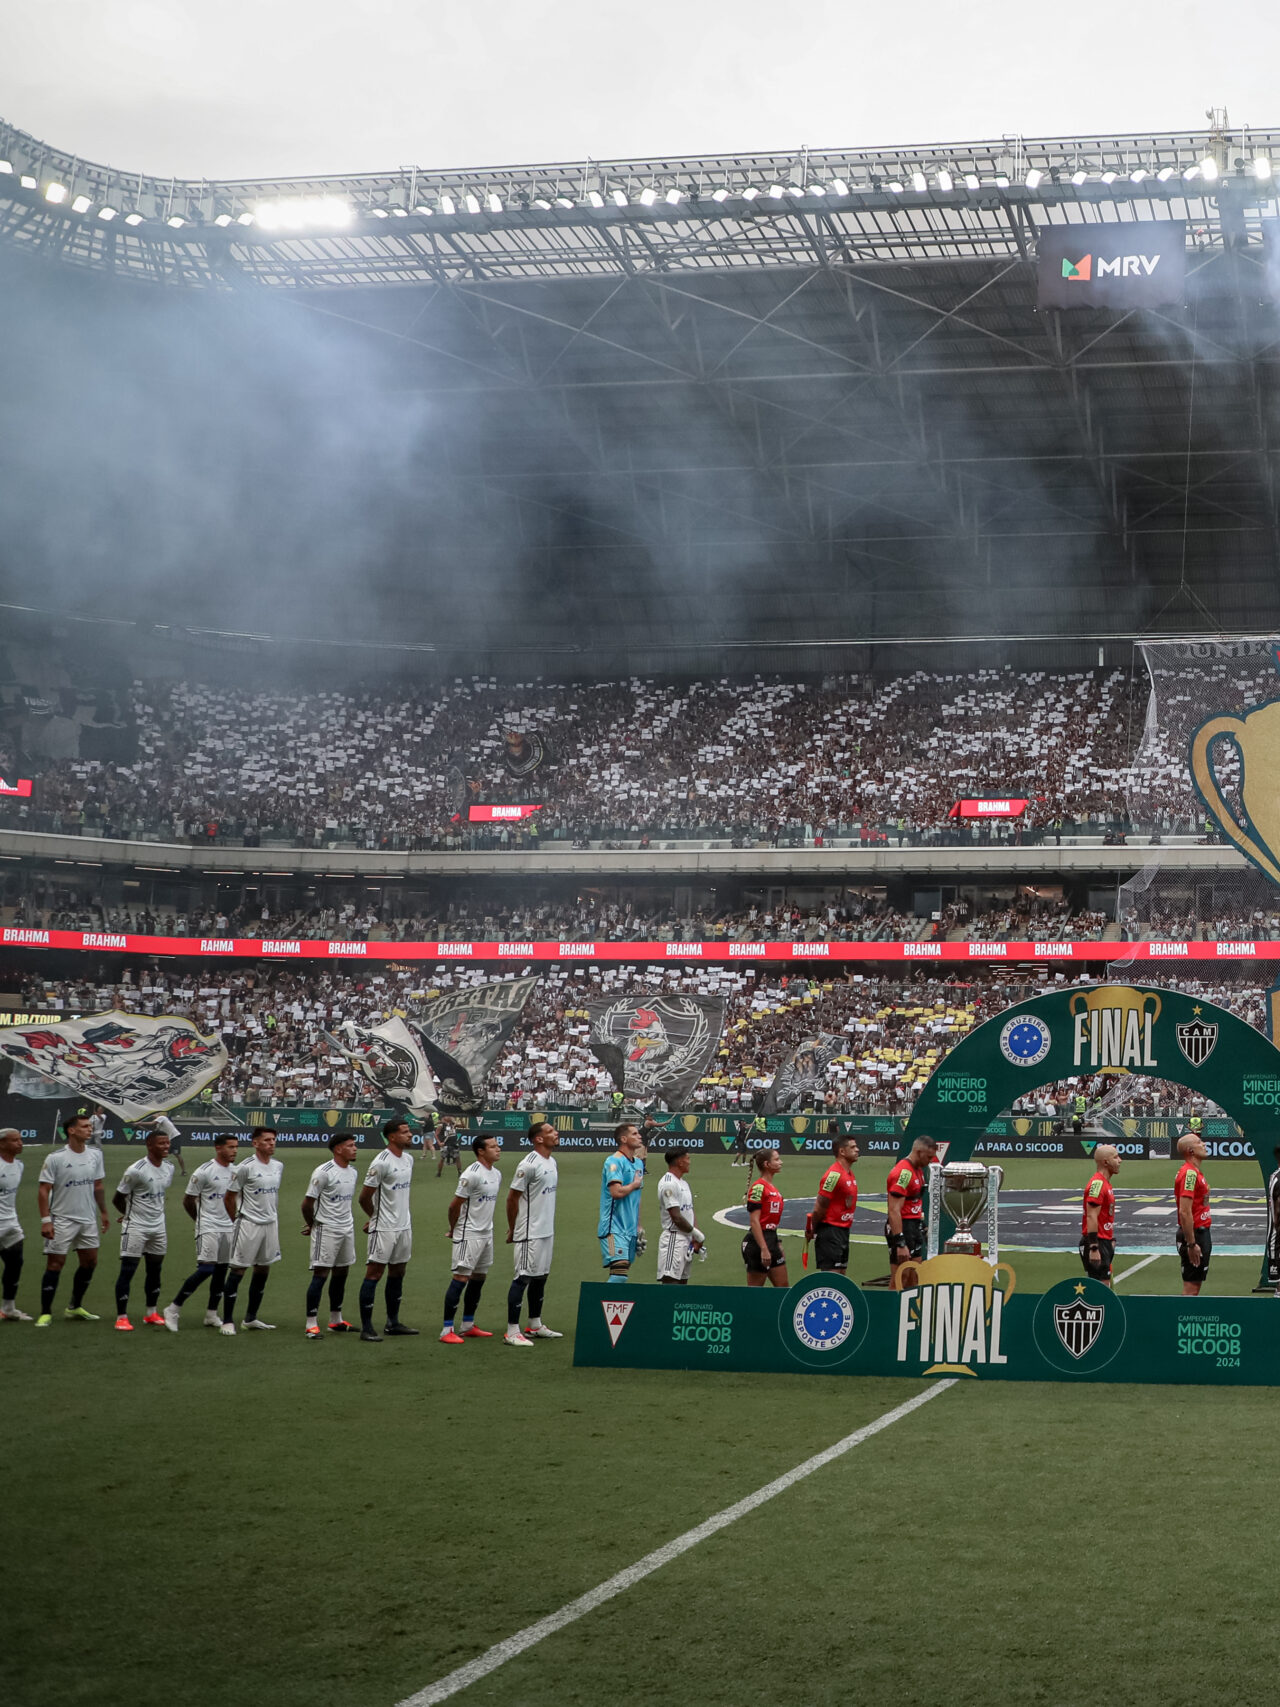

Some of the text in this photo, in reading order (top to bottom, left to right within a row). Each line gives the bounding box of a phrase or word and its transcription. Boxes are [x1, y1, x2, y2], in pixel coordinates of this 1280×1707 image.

[1097, 255, 1161, 277] MRV
[491, 807, 522, 817] BRAHMA
[978, 801, 1011, 812] BRAHMA
[3, 929, 49, 943] BRAHMA
[83, 934, 126, 947] BRAHMA
[262, 942, 300, 953] BRAHMA
[329, 943, 366, 954] BRAHMA
[438, 944, 472, 955] BRAHMA
[498, 944, 533, 955] BRAHMA
[560, 944, 594, 955] BRAHMA
[666, 944, 702, 955] BRAHMA
[729, 944, 765, 955] BRAHMA
[793, 944, 829, 955] BRAHMA
[904, 944, 941, 955] BRAHMA
[969, 944, 1006, 955] BRAHMA
[1035, 944, 1072, 955] BRAHMA
[1150, 943, 1188, 955] BRAHMA
[1217, 943, 1256, 955] BRAHMA
[1006, 1017, 1046, 1032] CRUZEIRO
[1182, 1028, 1212, 1036] CAM
[1074, 1008, 1157, 1068] FINAL
[1002, 1036, 1049, 1064] ESPORTE CLUBE
[937, 1078, 987, 1089] MINEIRO
[937, 1090, 987, 1103] SICOOB
[968, 1105, 988, 1113] 2024
[191, 1132, 211, 1141] SAIA
[296, 1133, 319, 1143] PARA
[320, 1133, 329, 1143] O
[744, 1138, 780, 1148] COOB
[806, 1140, 833, 1150] SICO
[868, 1141, 891, 1150] SAIA
[987, 1142, 1013, 1152] PARA
[1014, 1142, 1023, 1152] O
[1026, 1143, 1063, 1152] SICOOB
[932, 1192, 940, 1220] SICOOB
[988, 1208, 996, 1236] SICOOB
[988, 1237, 996, 1255] 2024
[801, 1290, 848, 1309] CRUZEIRO
[606, 1303, 629, 1314] FMF
[674, 1302, 713, 1310] CAMPEONATO
[672, 1310, 734, 1325] MINEIRO
[1061, 1310, 1097, 1321] CAM
[897, 1285, 1008, 1364] FINAL
[671, 1326, 732, 1342] SICOOB
[796, 1313, 851, 1348] ESPORTE CLUBE
[1177, 1323, 1241, 1338] MINEIRO
[707, 1344, 730, 1354] 2024
[1177, 1338, 1241, 1355] SICOOB
[1216, 1357, 1241, 1367] 2024
